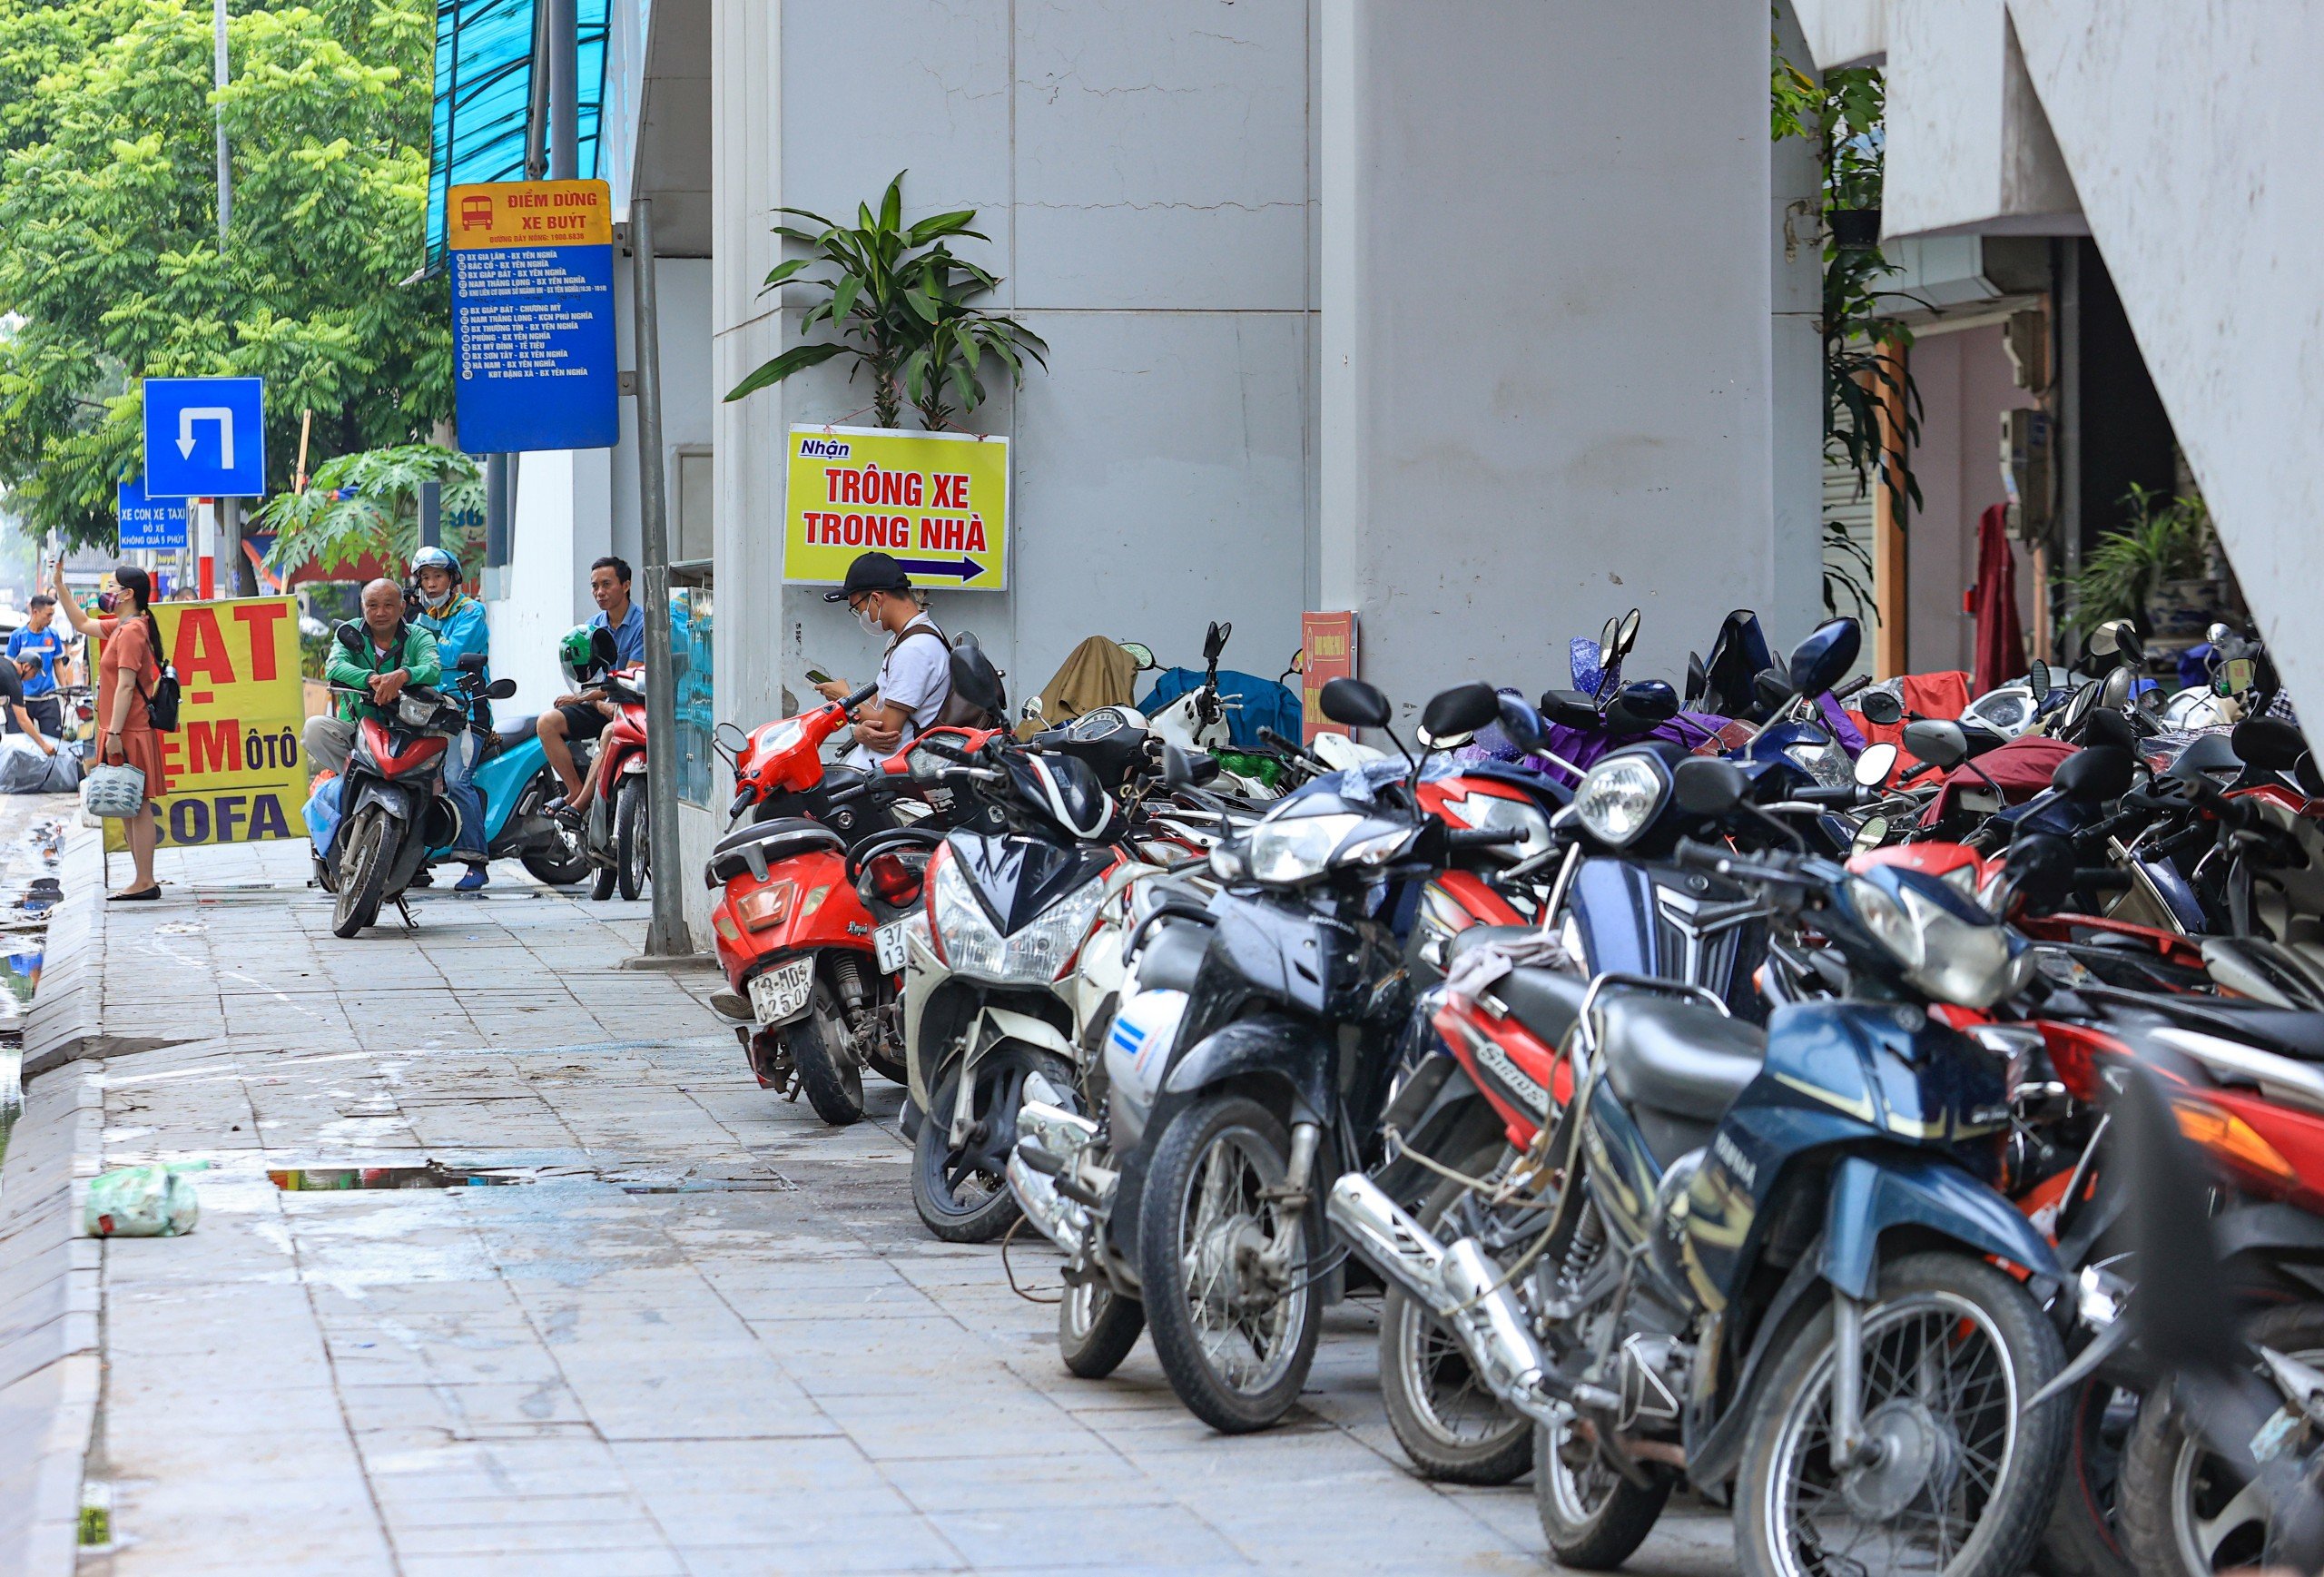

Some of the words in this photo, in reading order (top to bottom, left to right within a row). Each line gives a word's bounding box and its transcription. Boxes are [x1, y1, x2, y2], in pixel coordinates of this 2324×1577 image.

[508, 189, 548, 208] ĐIỂM
[553, 190, 597, 207] DỪNG
[522, 216, 542, 230] XE
[547, 212, 586, 229] BUÝT
[522, 251, 535, 259] YÊN
[537, 250, 558, 258] NGHĨA
[512, 260, 525, 268] YÊN
[527, 259, 549, 268] NGHĨA
[479, 270, 496, 278] GIÁP
[545, 267, 567, 276] NGHĨA
[487, 278, 510, 287] THĂNG
[564, 275, 586, 284] NGHĨA
[482, 305, 498, 314] GIÁP
[489, 314, 512, 322] THĂNG
[571, 311, 593, 320] NGHĨA
[541, 322, 555, 330] YÊN
[557, 321, 578, 330] NGHĨA
[472, 333, 496, 342] PHÙNG
[514, 332, 527, 340] YÊN
[529, 331, 551, 340] NGHĨA
[529, 341, 545, 349] TIÊU
[531, 350, 544, 358] YÊN
[546, 349, 568, 358] NGHĨA
[472, 360, 483, 369] HÀ
[519, 360, 532, 368] YÊN
[534, 359, 556, 367] NGHĨA
[551, 368, 565, 376] YÊN
[566, 367, 588, 376] NGHĨA
[801, 439, 850, 459] Nhận
[826, 463, 922, 507] TRÔNG
[932, 474, 969, 509] XE
[121, 509, 132, 521] XE
[153, 508, 164, 520] XE
[168, 508, 185, 520] TAXI
[155, 524, 165, 533] XE
[803, 513, 910, 548] TRONG
[920, 514, 986, 552] NHÀ
[121, 535, 145, 545] KHÔNG
[146, 534, 160, 545] QUÁ
[167, 534, 184, 544] PHÚT
[98, 603, 287, 704] ẠT
